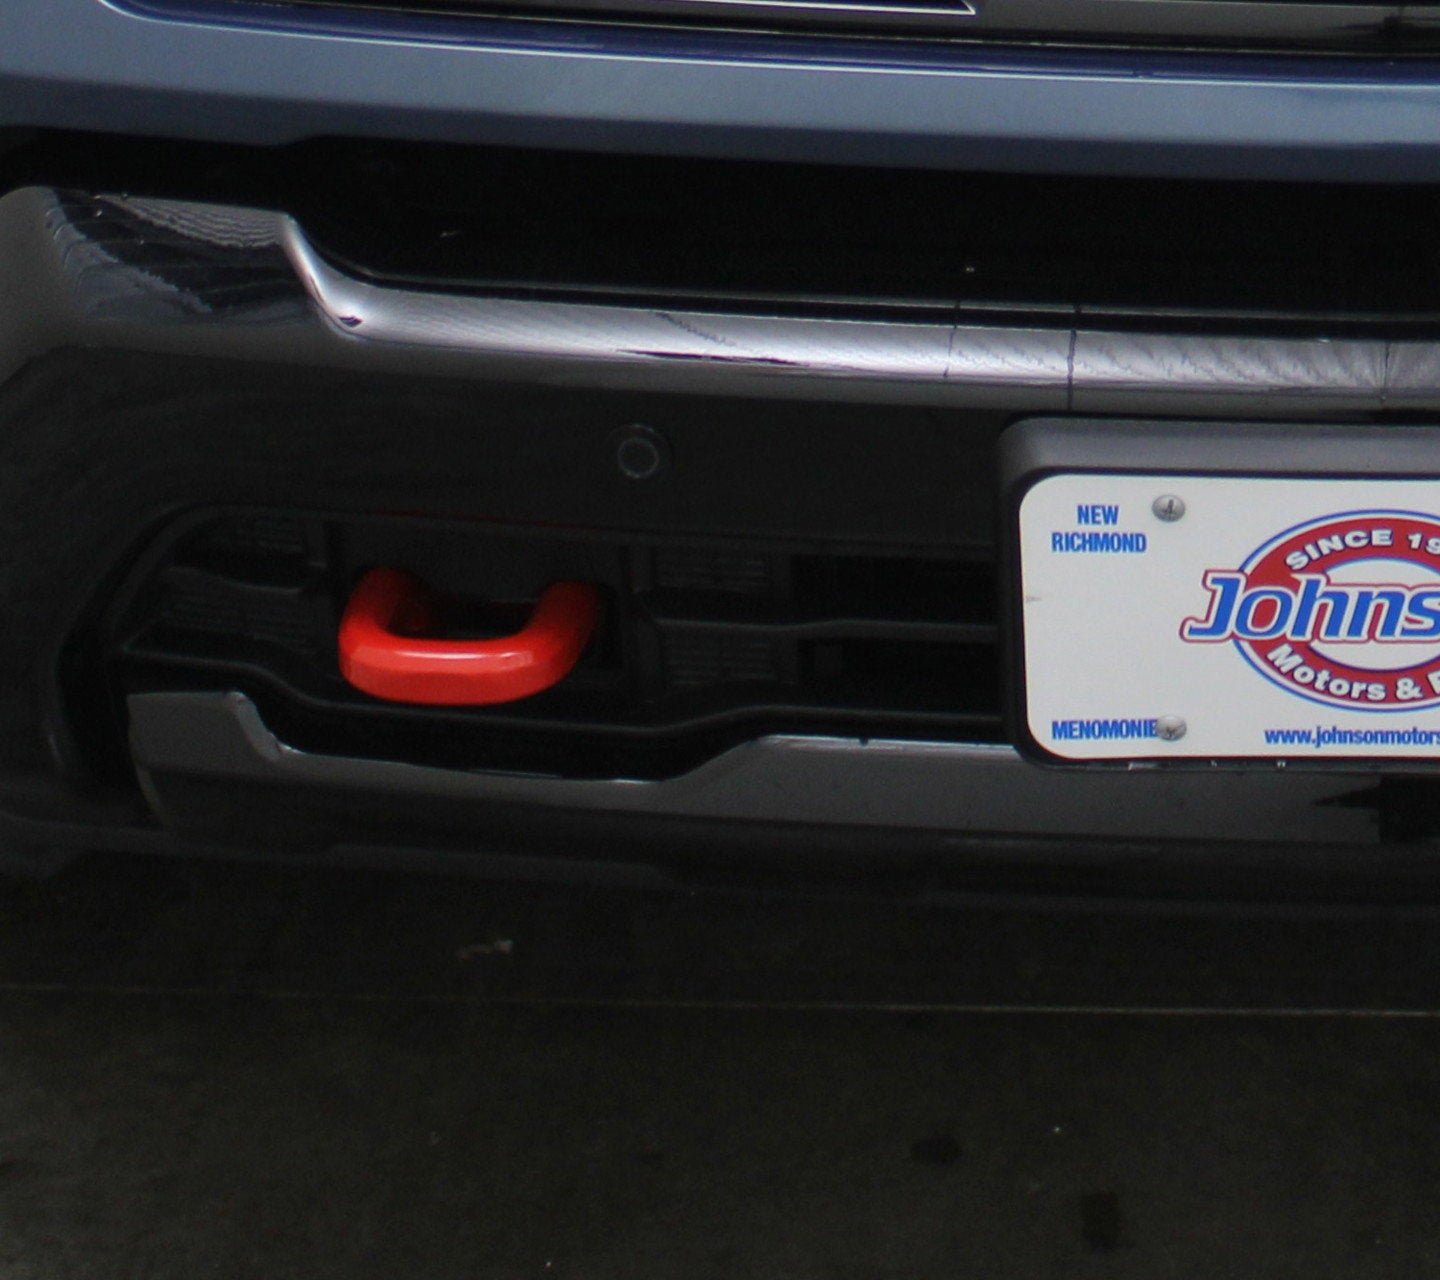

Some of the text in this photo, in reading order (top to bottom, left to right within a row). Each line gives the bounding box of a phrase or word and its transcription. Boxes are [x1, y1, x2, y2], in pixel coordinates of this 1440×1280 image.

[1076, 504, 1120, 525] NEW
[1051, 531, 1148, 553] RICHMOND
[1284, 528, 1394, 572] SINCE
[1265, 642, 1387, 702] Motors
[1394, 676, 1424, 701] &
[1051, 718, 1160, 740] MENOMONIE
